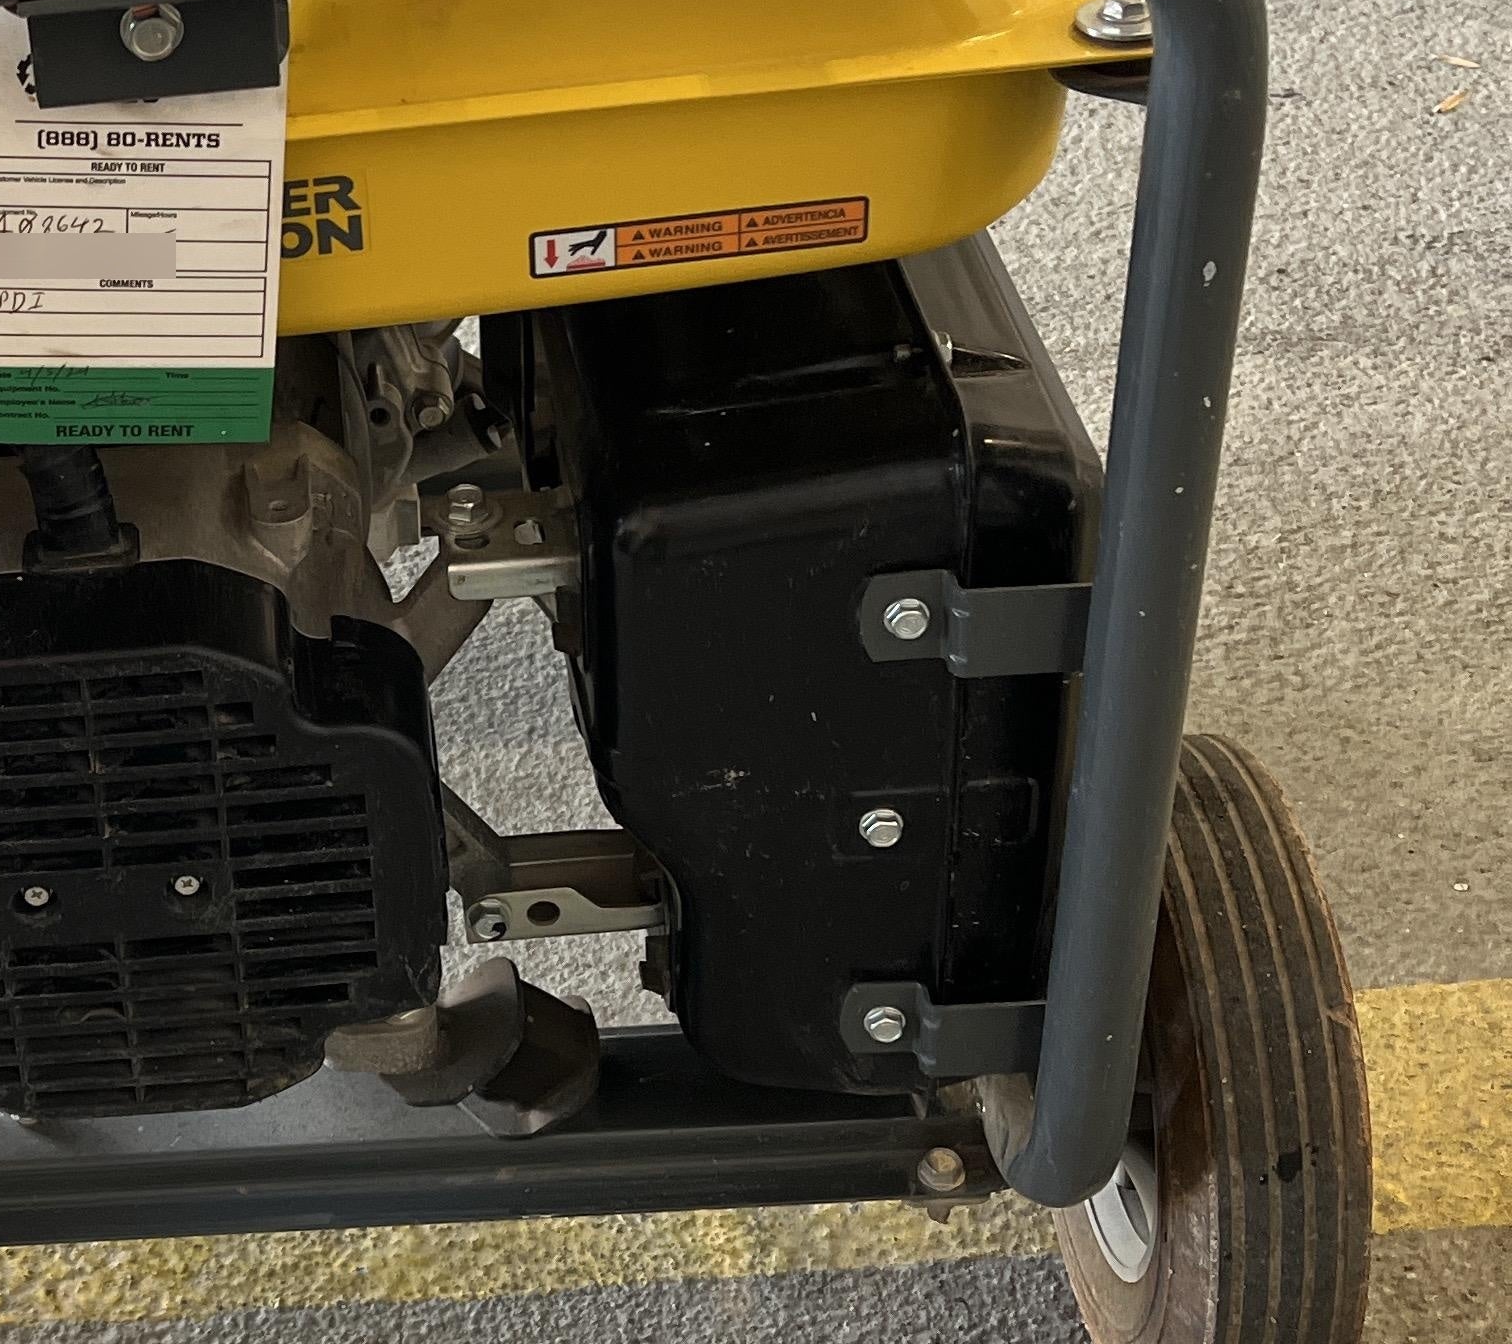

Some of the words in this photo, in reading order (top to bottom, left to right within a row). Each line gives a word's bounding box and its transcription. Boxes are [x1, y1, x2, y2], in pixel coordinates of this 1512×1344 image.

[37, 129, 99, 150] (888)
[106, 130, 221, 149] 80-RENTS
[91, 161, 123, 172] READY
[125, 162, 138, 173] TO
[140, 162, 166, 174] RENT
[762, 207, 847, 227] ADVERTENCIA
[648, 221, 724, 239] WARNING
[761, 225, 860, 246] AVERTISSEMENT
[648, 240, 724, 259] WARNING
[99, 279, 154, 288] COMMENTS
[55, 424, 117, 438] READY
[120, 425, 143, 438] TO
[147, 425, 196, 438] RENT
